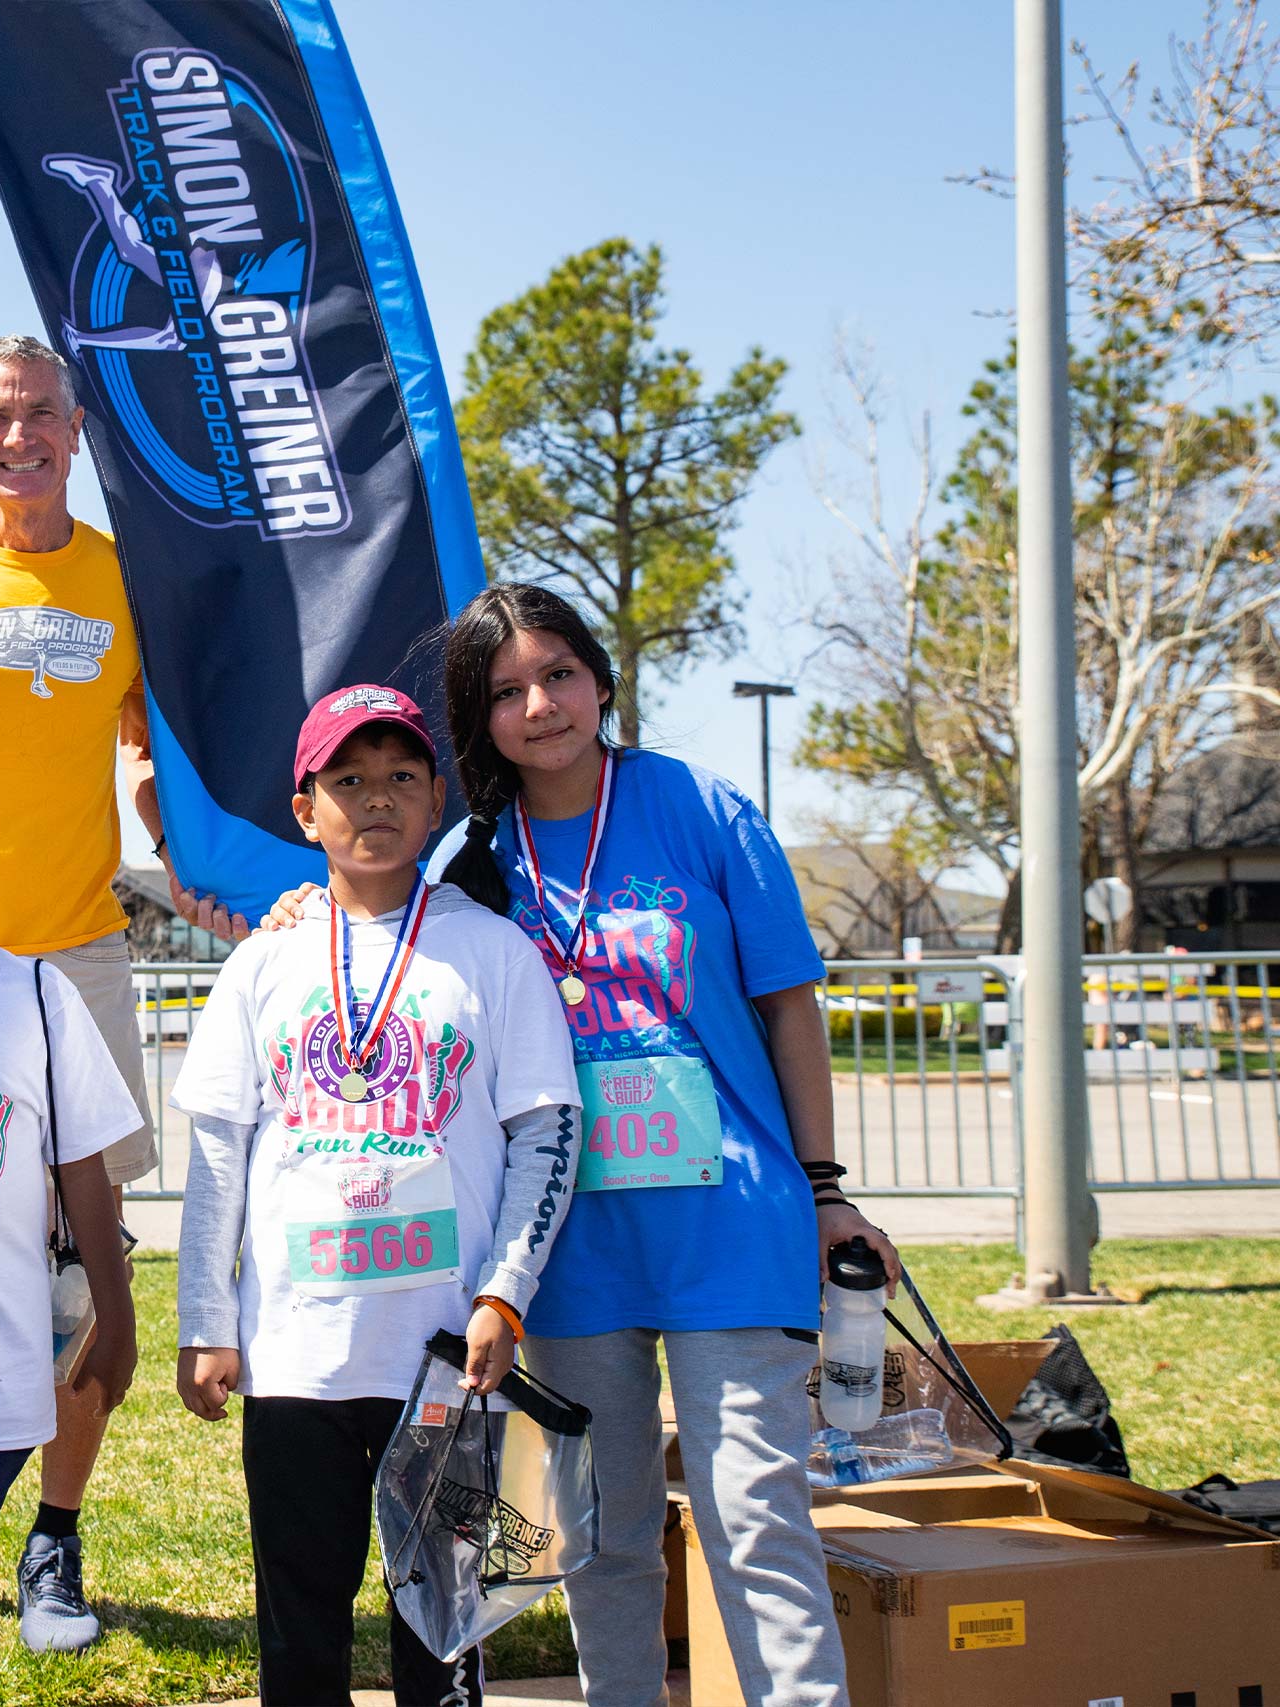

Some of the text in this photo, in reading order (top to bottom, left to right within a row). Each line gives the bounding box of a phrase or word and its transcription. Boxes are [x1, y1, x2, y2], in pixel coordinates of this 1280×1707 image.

[117, 88, 170, 210] TRACK
[159, 249, 207, 341] FIELD
[187, 352, 254, 516] PROGRAM
[142, 54, 346, 532] SIMON GREINER
[34, 616, 113, 646] GREINER
[10, 641, 44, 650] FIELD
[48, 641, 103, 655] PROGRAM
[311, 1012, 337, 1051] BOL
[681, 1042, 704, 1051] JONE
[311, 1057, 327, 1080] BE
[613, 1075, 641, 1090] RED
[614, 1090, 642, 1105] BUD
[360, 1131, 429, 1157] Run
[588, 1111, 680, 1160] 403
[351, 1180, 380, 1194] RED
[602, 1172, 670, 1186] Good For One
[352, 1194, 380, 1209] BUD
[310, 1220, 434, 1276] 5566
[500, 1510, 553, 1549] GREINER
[500, 1536, 540, 1557] ROGRAM
